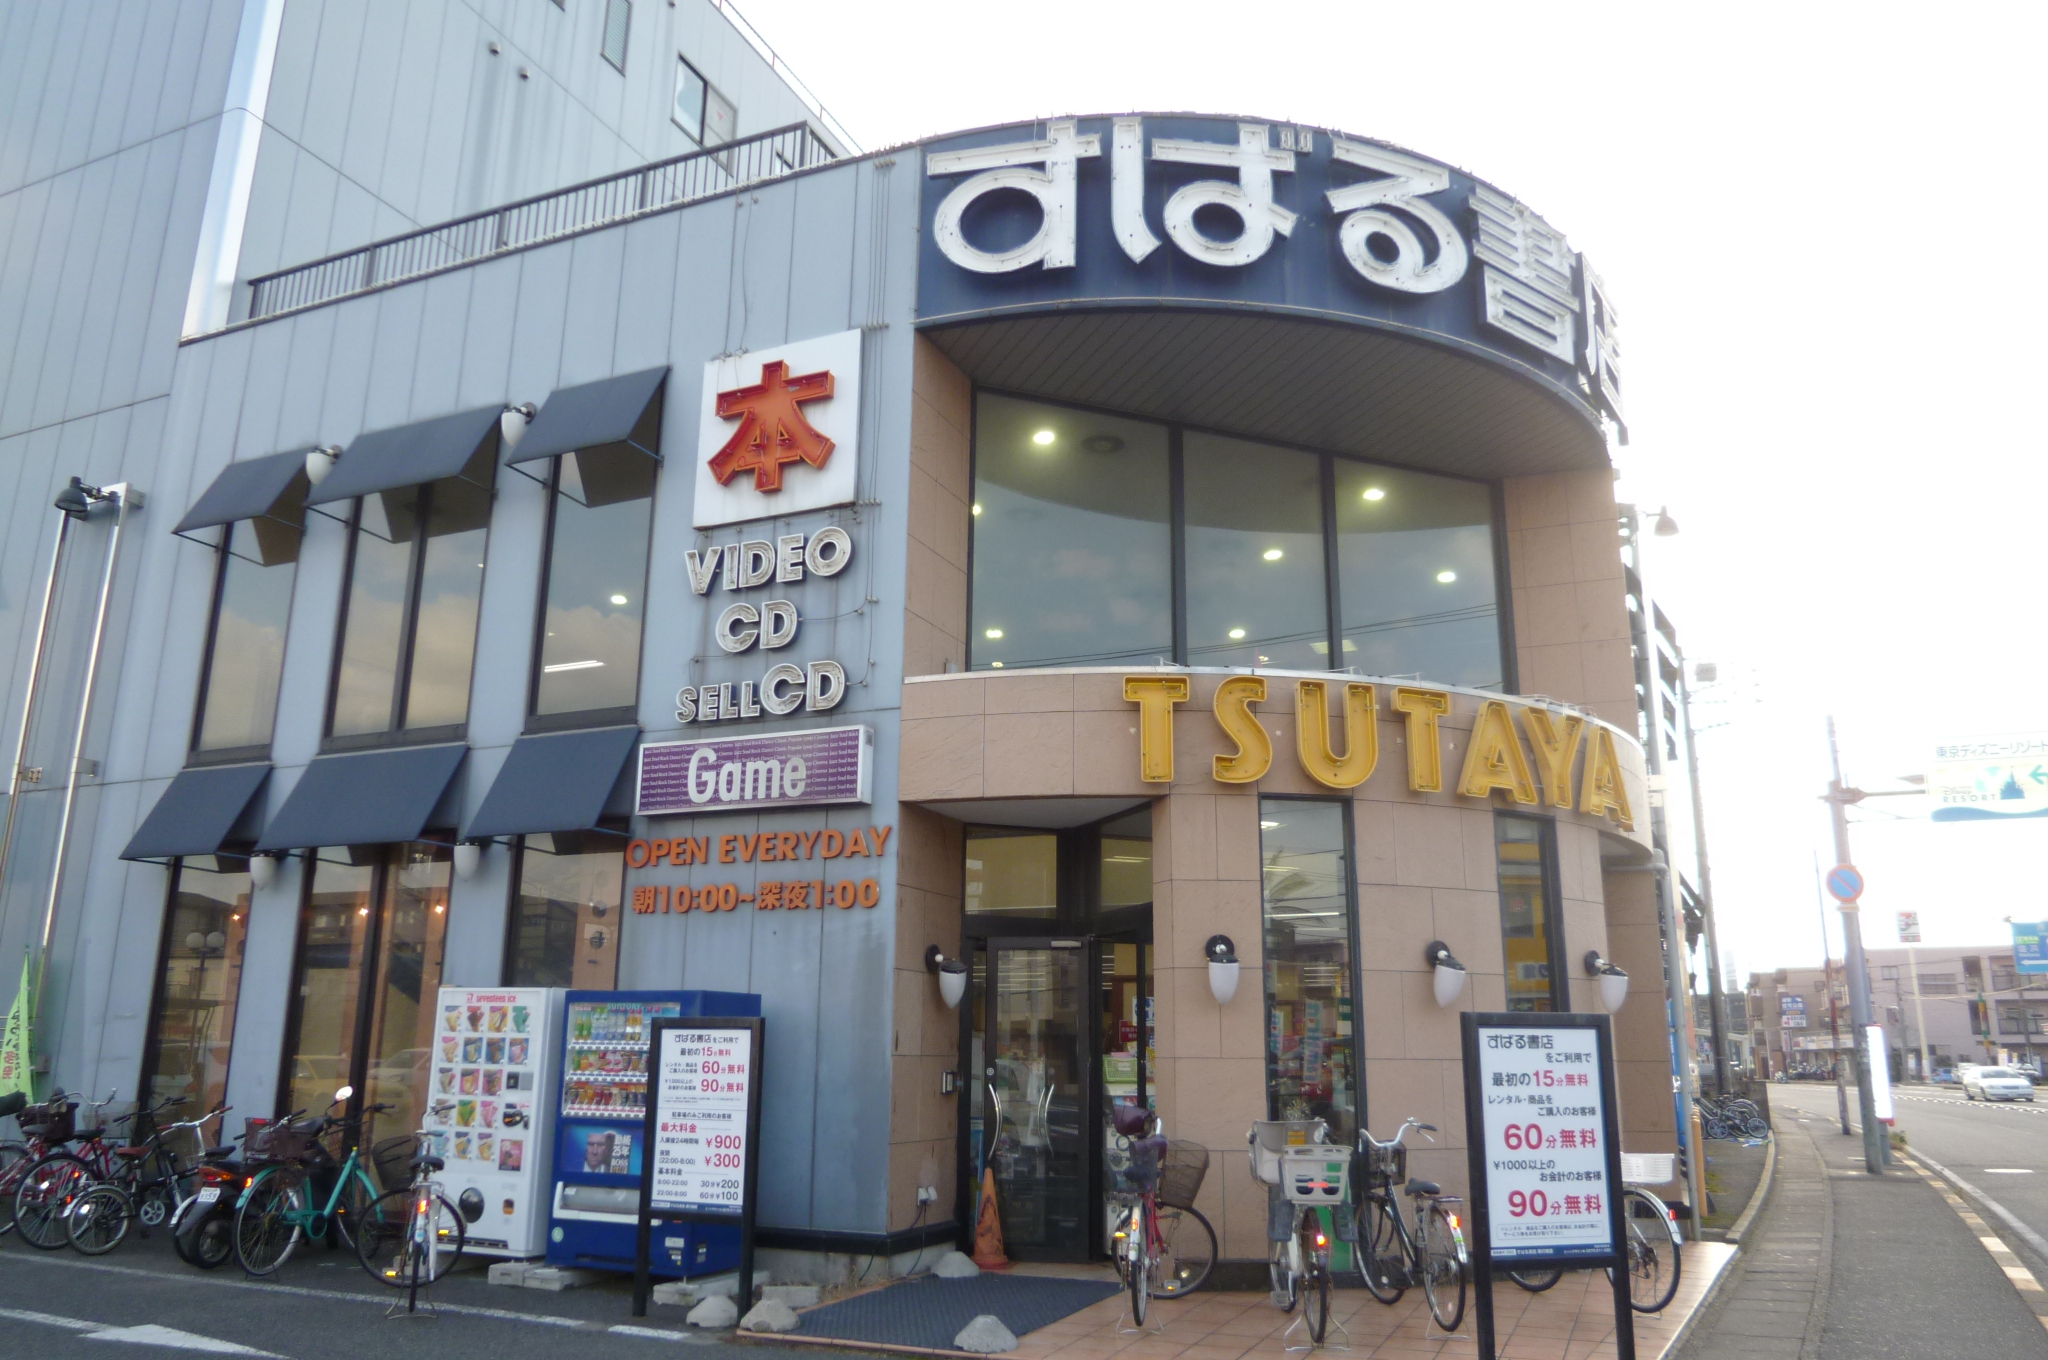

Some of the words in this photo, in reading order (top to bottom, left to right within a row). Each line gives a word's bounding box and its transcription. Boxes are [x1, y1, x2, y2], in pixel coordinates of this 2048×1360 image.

[927, 117, 1628, 433] すばる書店
[707, 359, 836, 493] 本
[684, 526, 853, 595] VIDEO
[715, 599, 799, 653] CD
[675, 682, 760, 723] SELL
[760, 660, 847, 715] CD
[1122, 676, 1636, 832] TSUTAYA
[687, 747, 806, 803] Game
[1943, 794, 1996, 803] RESORT
[626, 836, 709, 868] OPEN
[718, 826, 892, 863] EVERYDAY
[476, 994, 506, 1002] seventeen
[507, 993, 517, 1003] ice
[674, 1034, 711, 1043] すばる書店
[1486, 1034, 1554, 1050] すばる書店
[680, 1047, 731, 1056] 最初の15分無料
[1545, 1052, 1592, 1064] をご利用で
[702, 1061, 745, 1074] 60分無料
[701, 1079, 744, 1092] 90分無料
[1491, 1070, 1588, 1087] 最初の15分無料
[1488, 1094, 1553, 1105] レンタル・商品を
[1537, 1106, 1596, 1117] ご購入のお客様
[661, 1122, 697, 1133] 最大料金
[706, 1135, 741, 1149] ¥900
[1503, 1123, 1596, 1150] 60分無料
[705, 1153, 740, 1168] ¥300
[1493, 1159, 1555, 1170] ¥1000以上の
[658, 1168, 682, 1176] 基本料金
[1539, 1171, 1602, 1182] お会計のお客様
[1508, 1189, 1602, 1217] 90分無料
